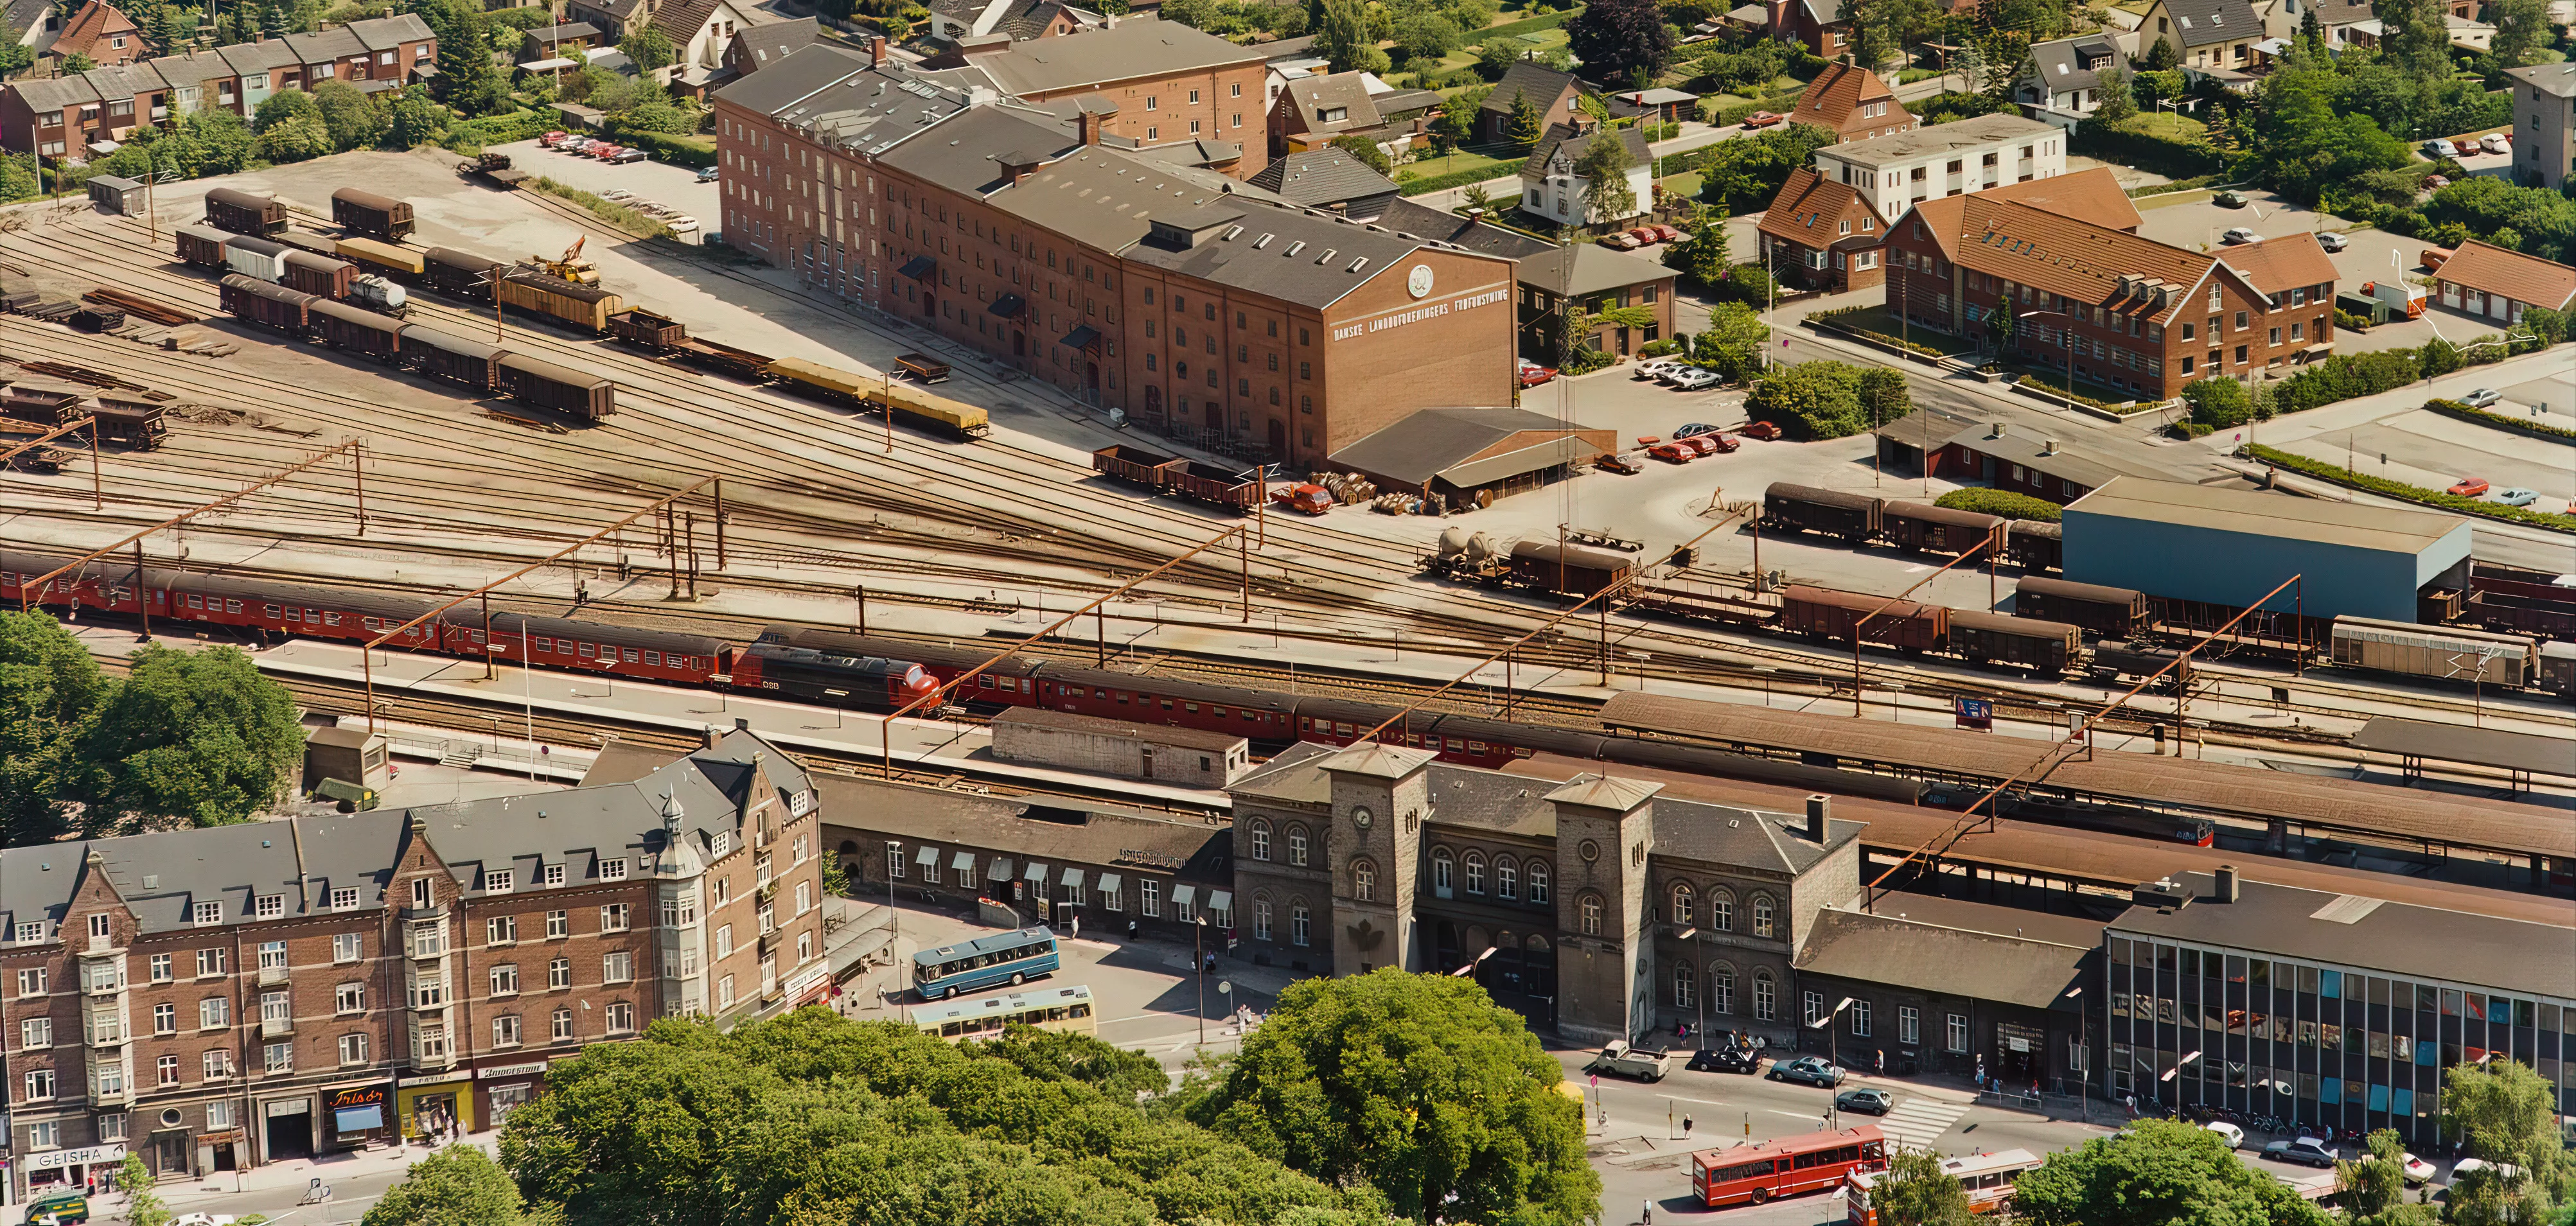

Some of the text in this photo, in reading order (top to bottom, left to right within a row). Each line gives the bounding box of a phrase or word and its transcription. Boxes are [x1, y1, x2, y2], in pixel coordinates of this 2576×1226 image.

[1334, 324, 1363, 341] DANSKE
[763, 681, 779, 690] DSB
[39, 1149, 101, 1166] GEISHA
